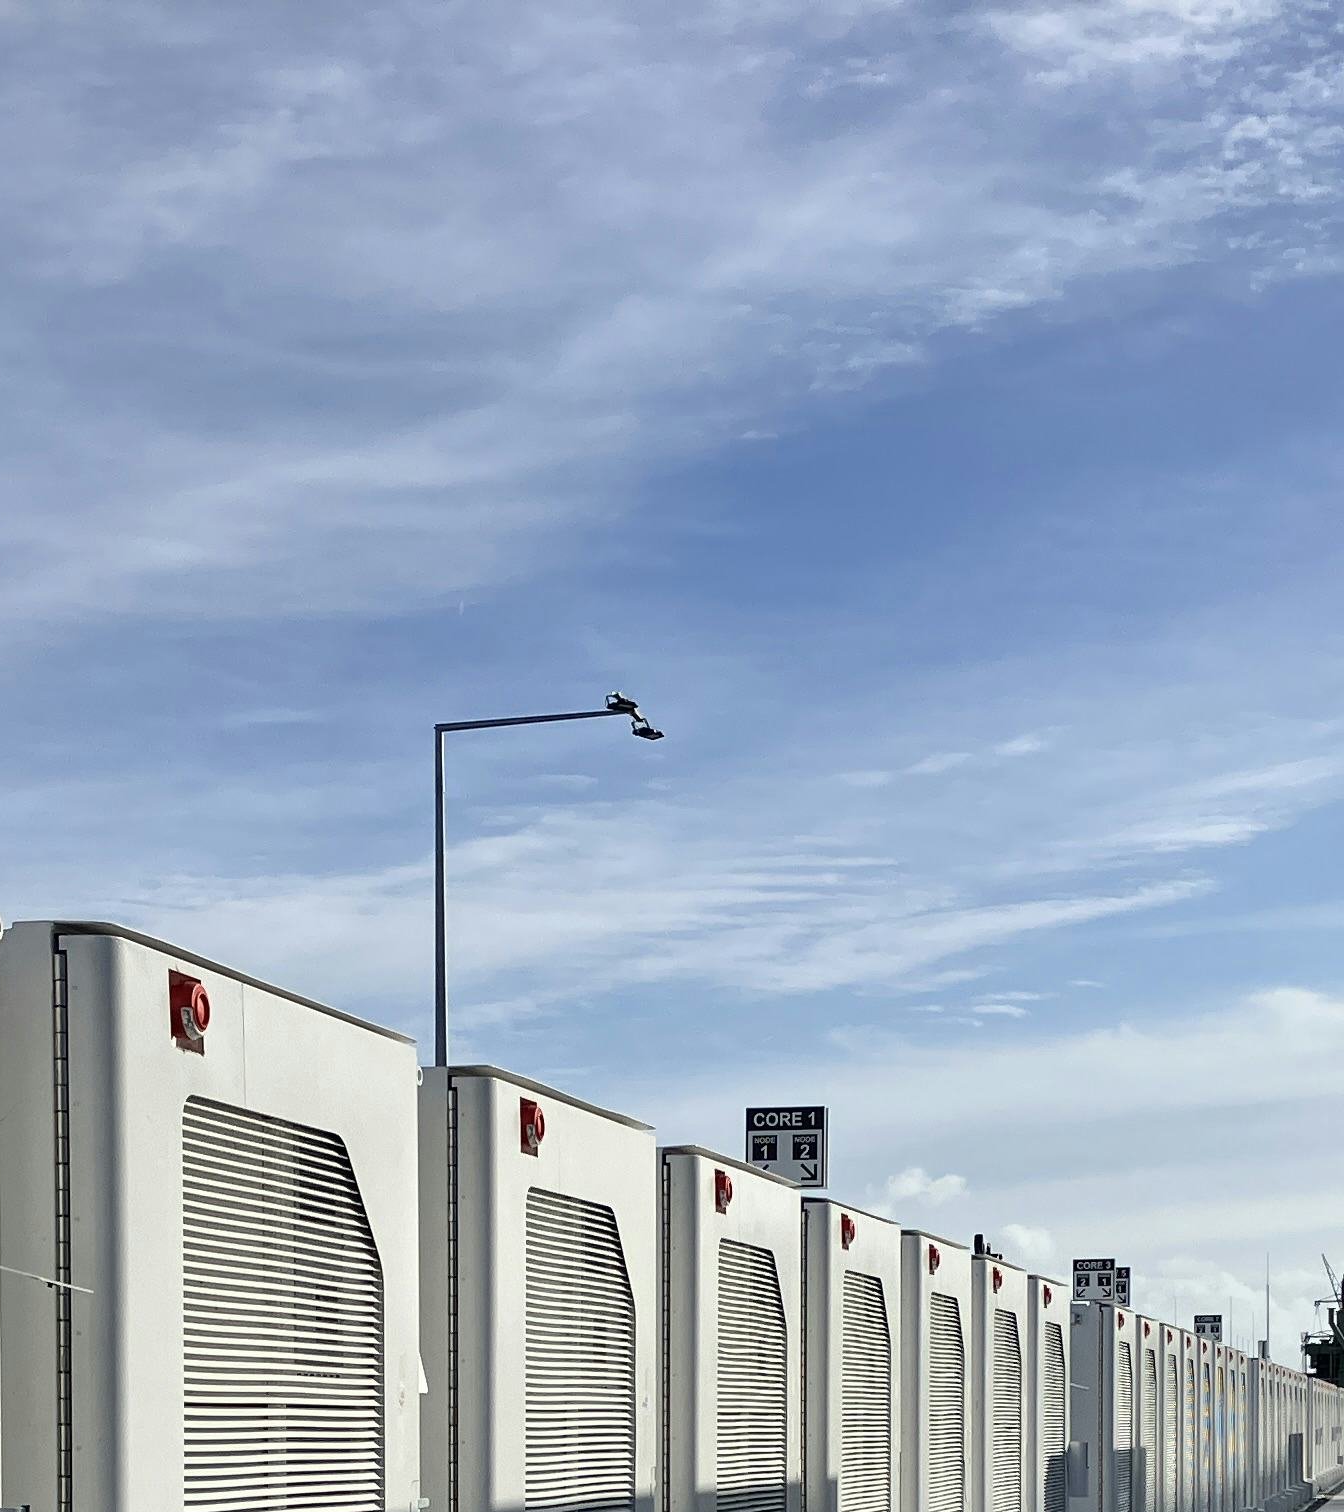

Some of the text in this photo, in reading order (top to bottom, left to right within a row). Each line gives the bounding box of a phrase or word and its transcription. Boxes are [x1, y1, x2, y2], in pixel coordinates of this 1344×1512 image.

[754, 1112, 815, 1126] CORE 1
[761, 1145, 768, 1159] 1
[800, 1144, 810, 1158] 2
[1077, 1261, 1111, 1270] CORE 3
